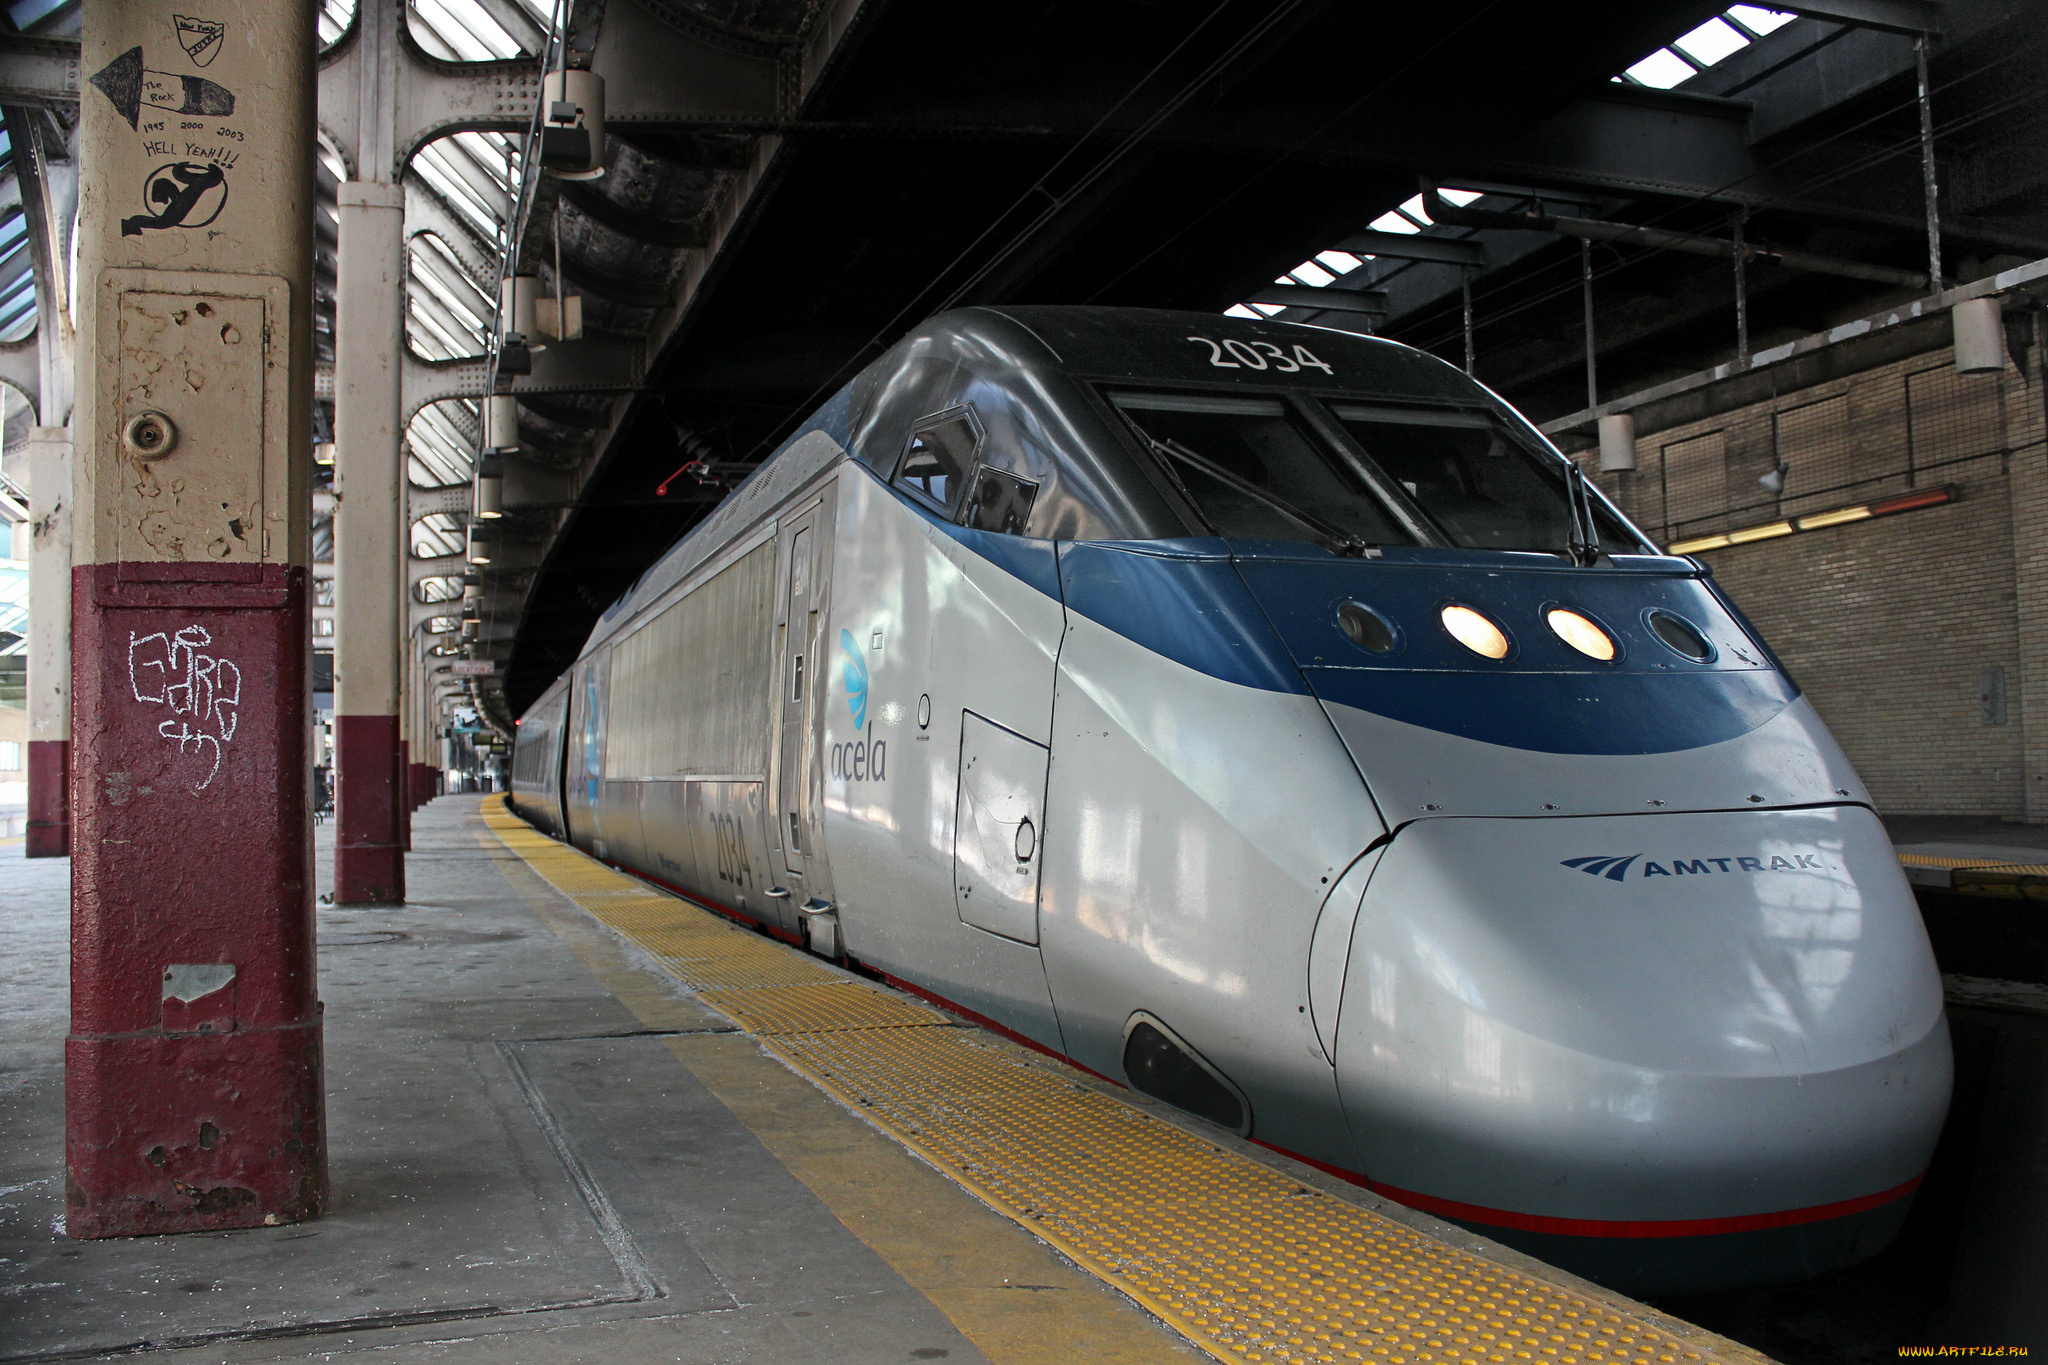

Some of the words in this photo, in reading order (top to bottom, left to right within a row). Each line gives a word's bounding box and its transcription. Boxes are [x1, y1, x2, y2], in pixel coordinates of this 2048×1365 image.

[143, 81, 162, 90] The
[143, 121, 165, 133] 1995
[180, 121, 204, 130] 2000
[216, 127, 244, 141] 2003
[143, 141, 176, 157] HELL
[185, 142, 240, 169] YEAH!!!
[1187, 337, 1334, 375] 2034
[453, 664, 486, 674] LOCATION
[831, 720, 887, 782] acela
[710, 811, 753, 890] 2034
[1643, 854, 1823, 878] AMTRAK
